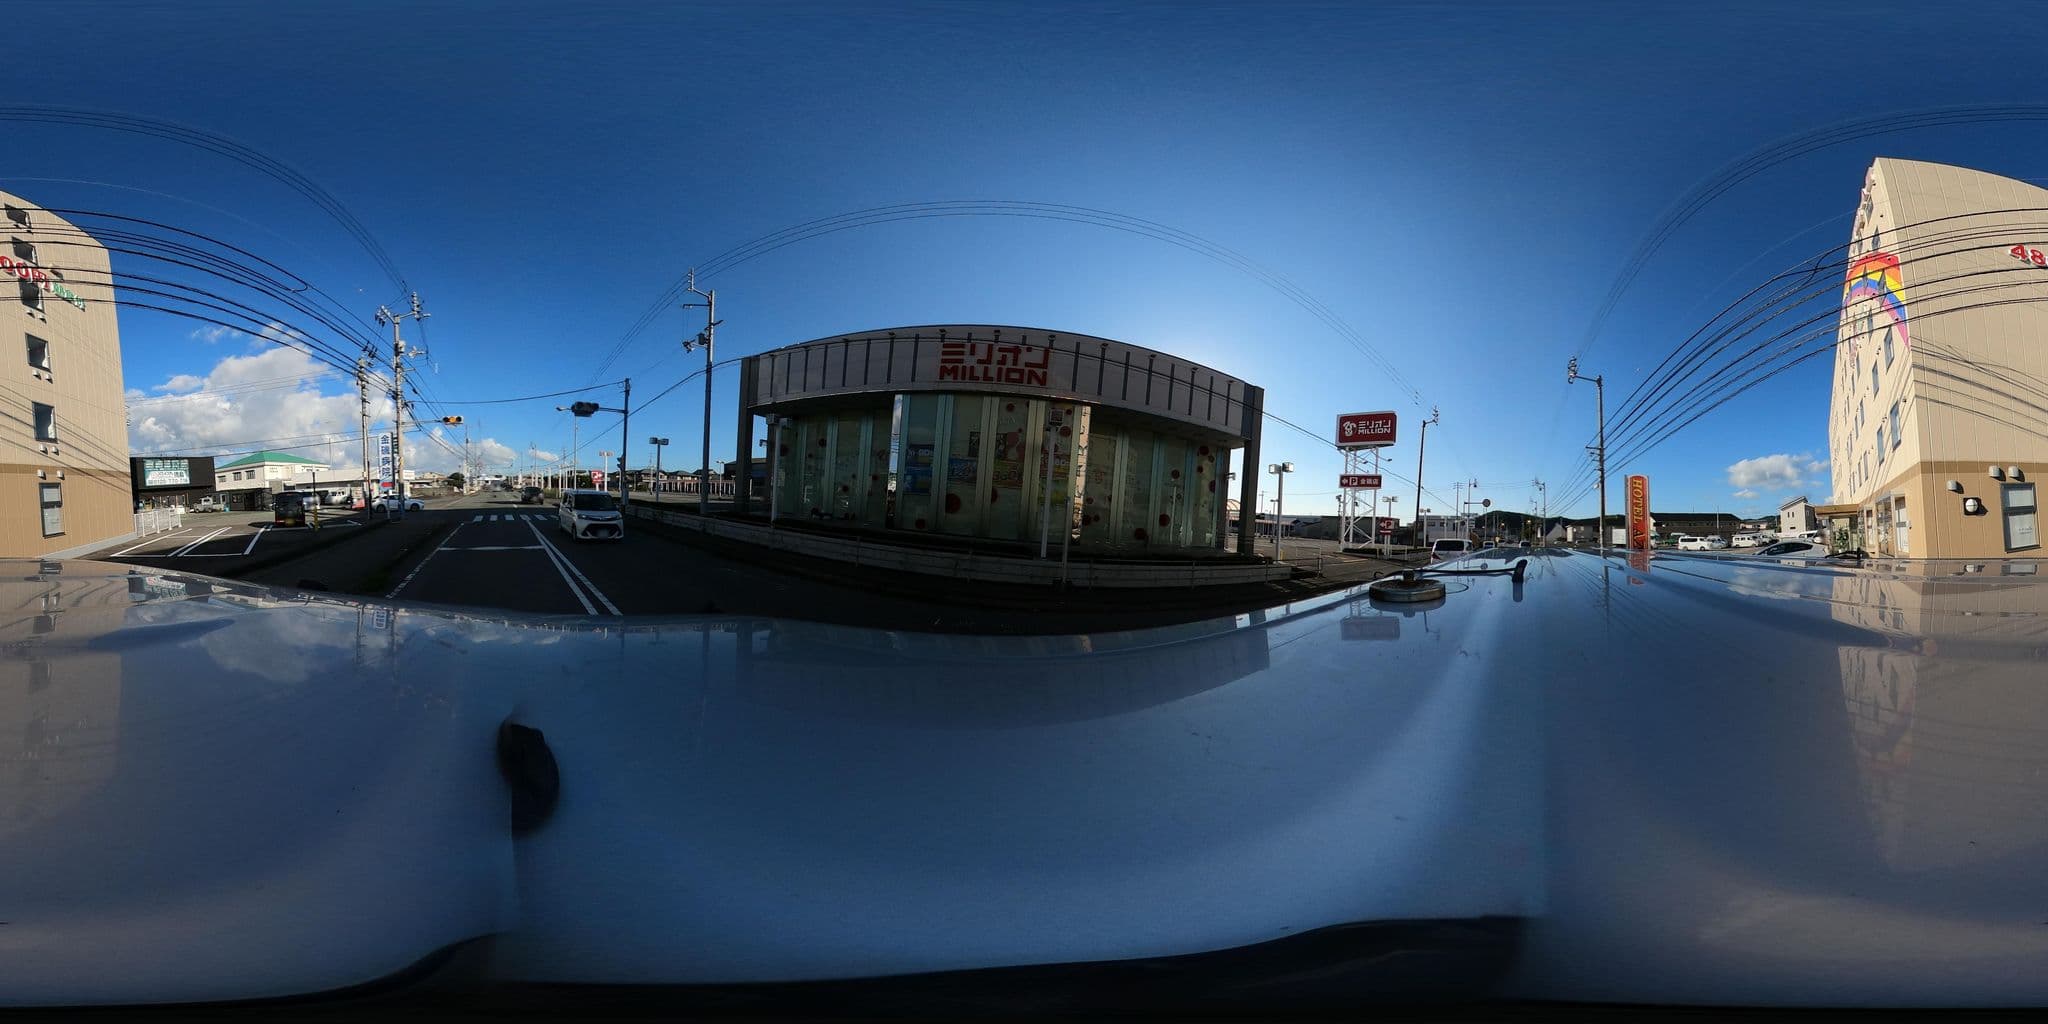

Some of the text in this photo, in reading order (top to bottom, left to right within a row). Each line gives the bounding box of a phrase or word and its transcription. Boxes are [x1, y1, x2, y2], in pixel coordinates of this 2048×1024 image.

[941, 343, 1050, 369] ミリオン
[939, 365, 1047, 385] MILLION
[1358, 420, 1391, 429] ミリオン
[1633, 478, 1643, 523] HOTEL
